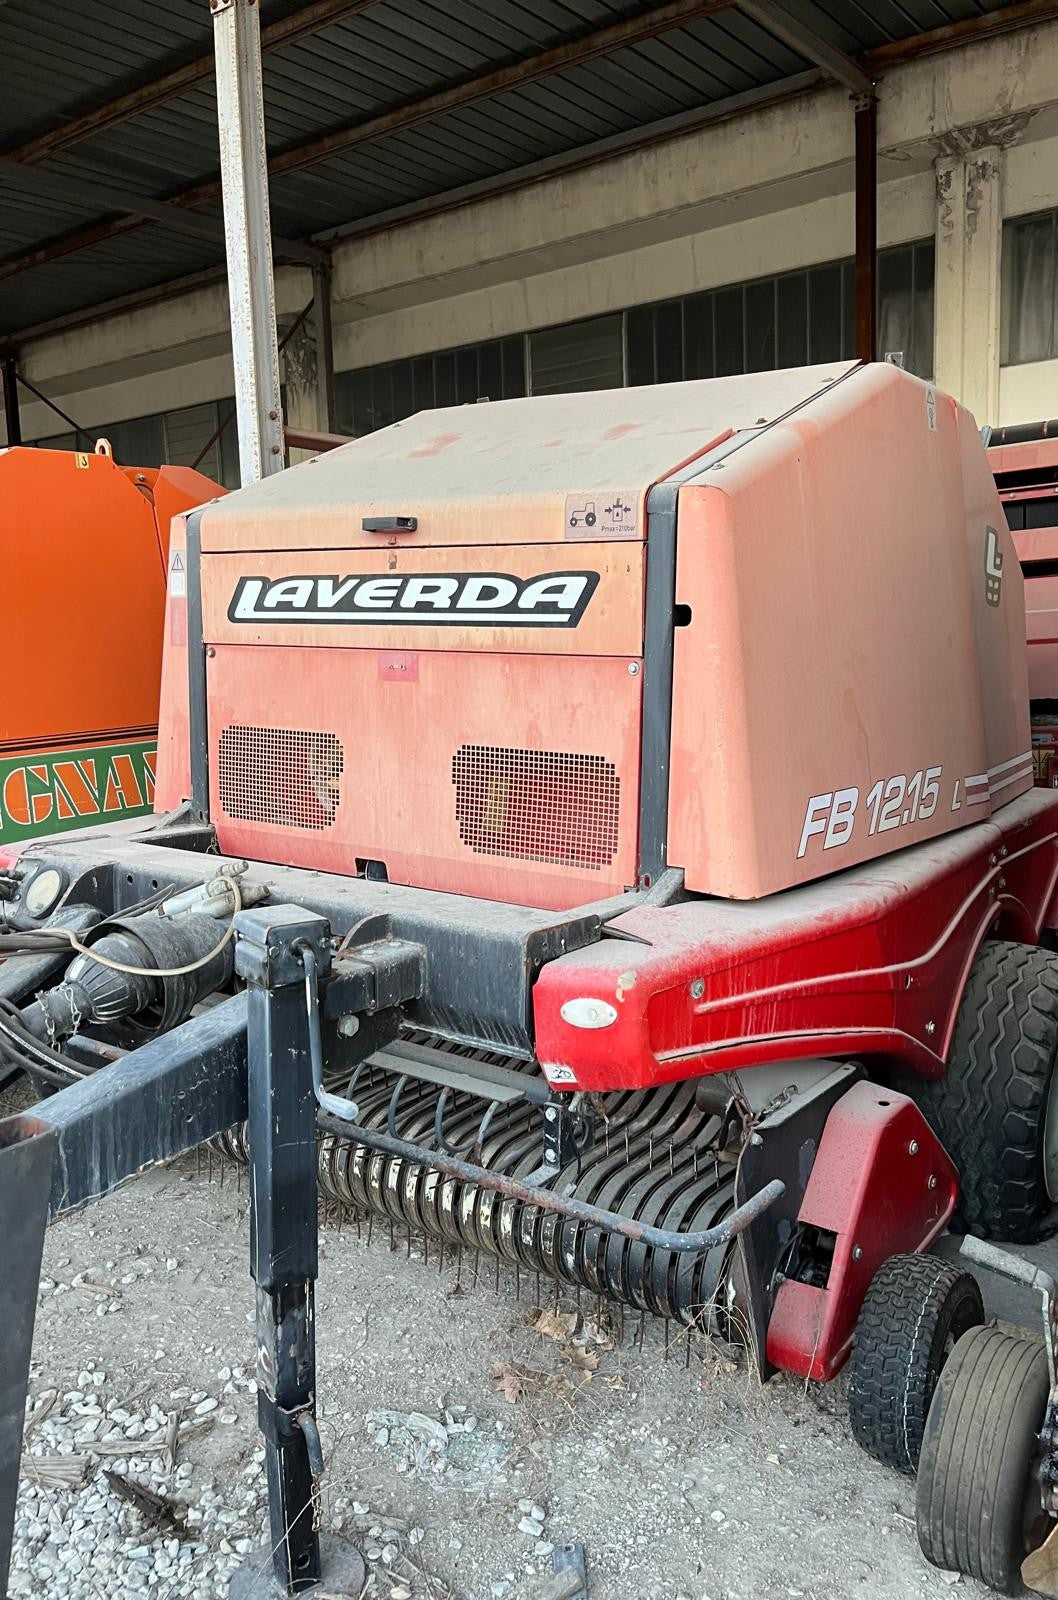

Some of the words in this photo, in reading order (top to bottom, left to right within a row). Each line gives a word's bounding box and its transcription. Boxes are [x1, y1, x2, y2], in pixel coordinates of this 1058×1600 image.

[234, 576, 589, 623] LAVERDA
[0, 751, 157, 829] GNA
[796, 786, 860, 860] FB
[866, 765, 944, 837] 12.15
[950, 779, 962, 812] L
